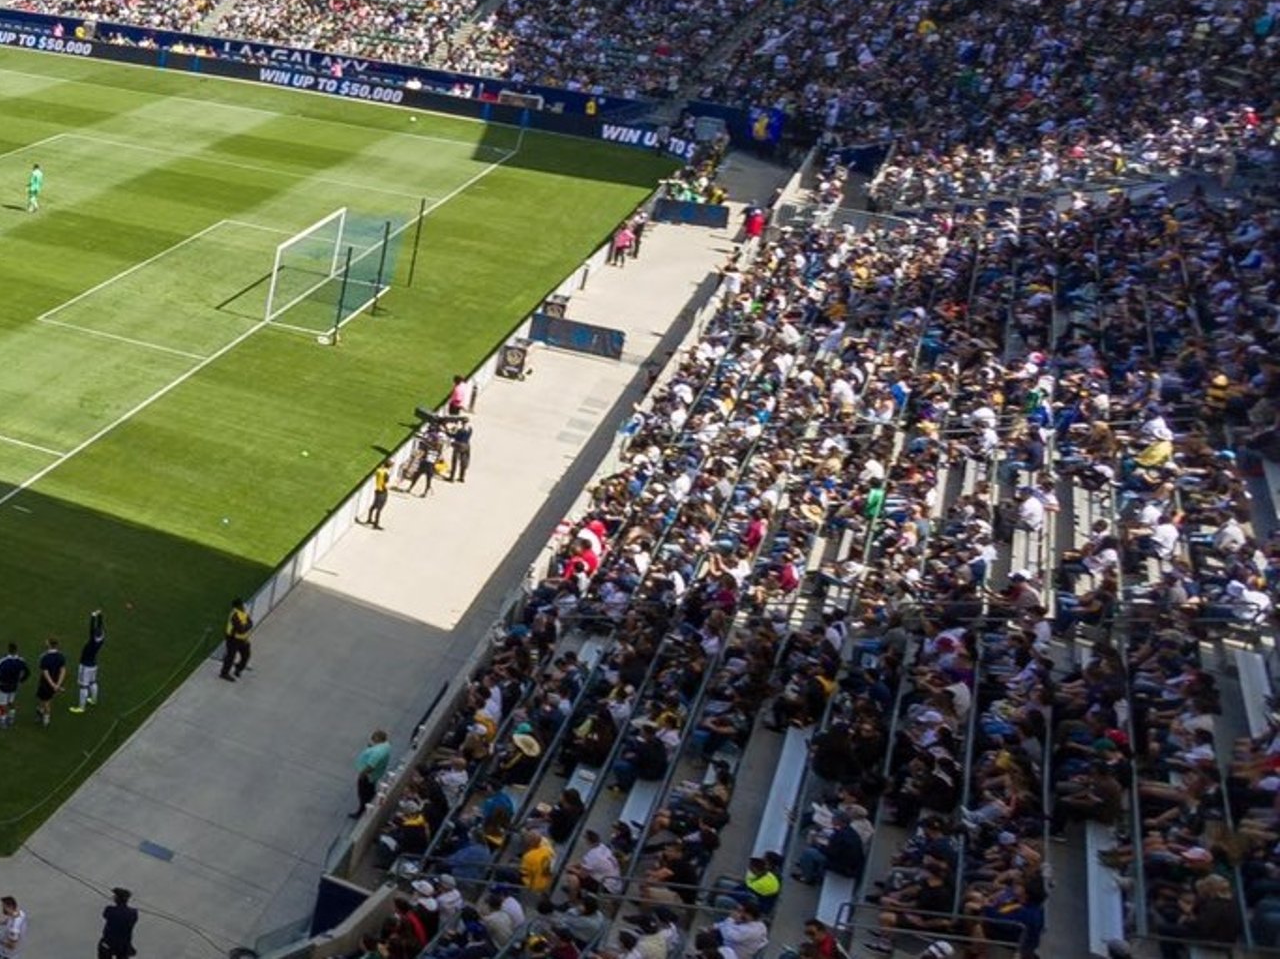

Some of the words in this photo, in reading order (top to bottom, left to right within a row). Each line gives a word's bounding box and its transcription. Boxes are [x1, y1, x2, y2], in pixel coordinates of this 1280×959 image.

[18, 32, 36, 47] TO
[38, 34, 93, 56] $50,000
[259, 67, 290, 85] WIN
[292, 70, 315, 88] UP
[317, 75, 338, 92] TO
[339, 78, 404, 104] $50,000
[601, 123, 640, 145] WIN
[668, 137, 684, 154] TO
